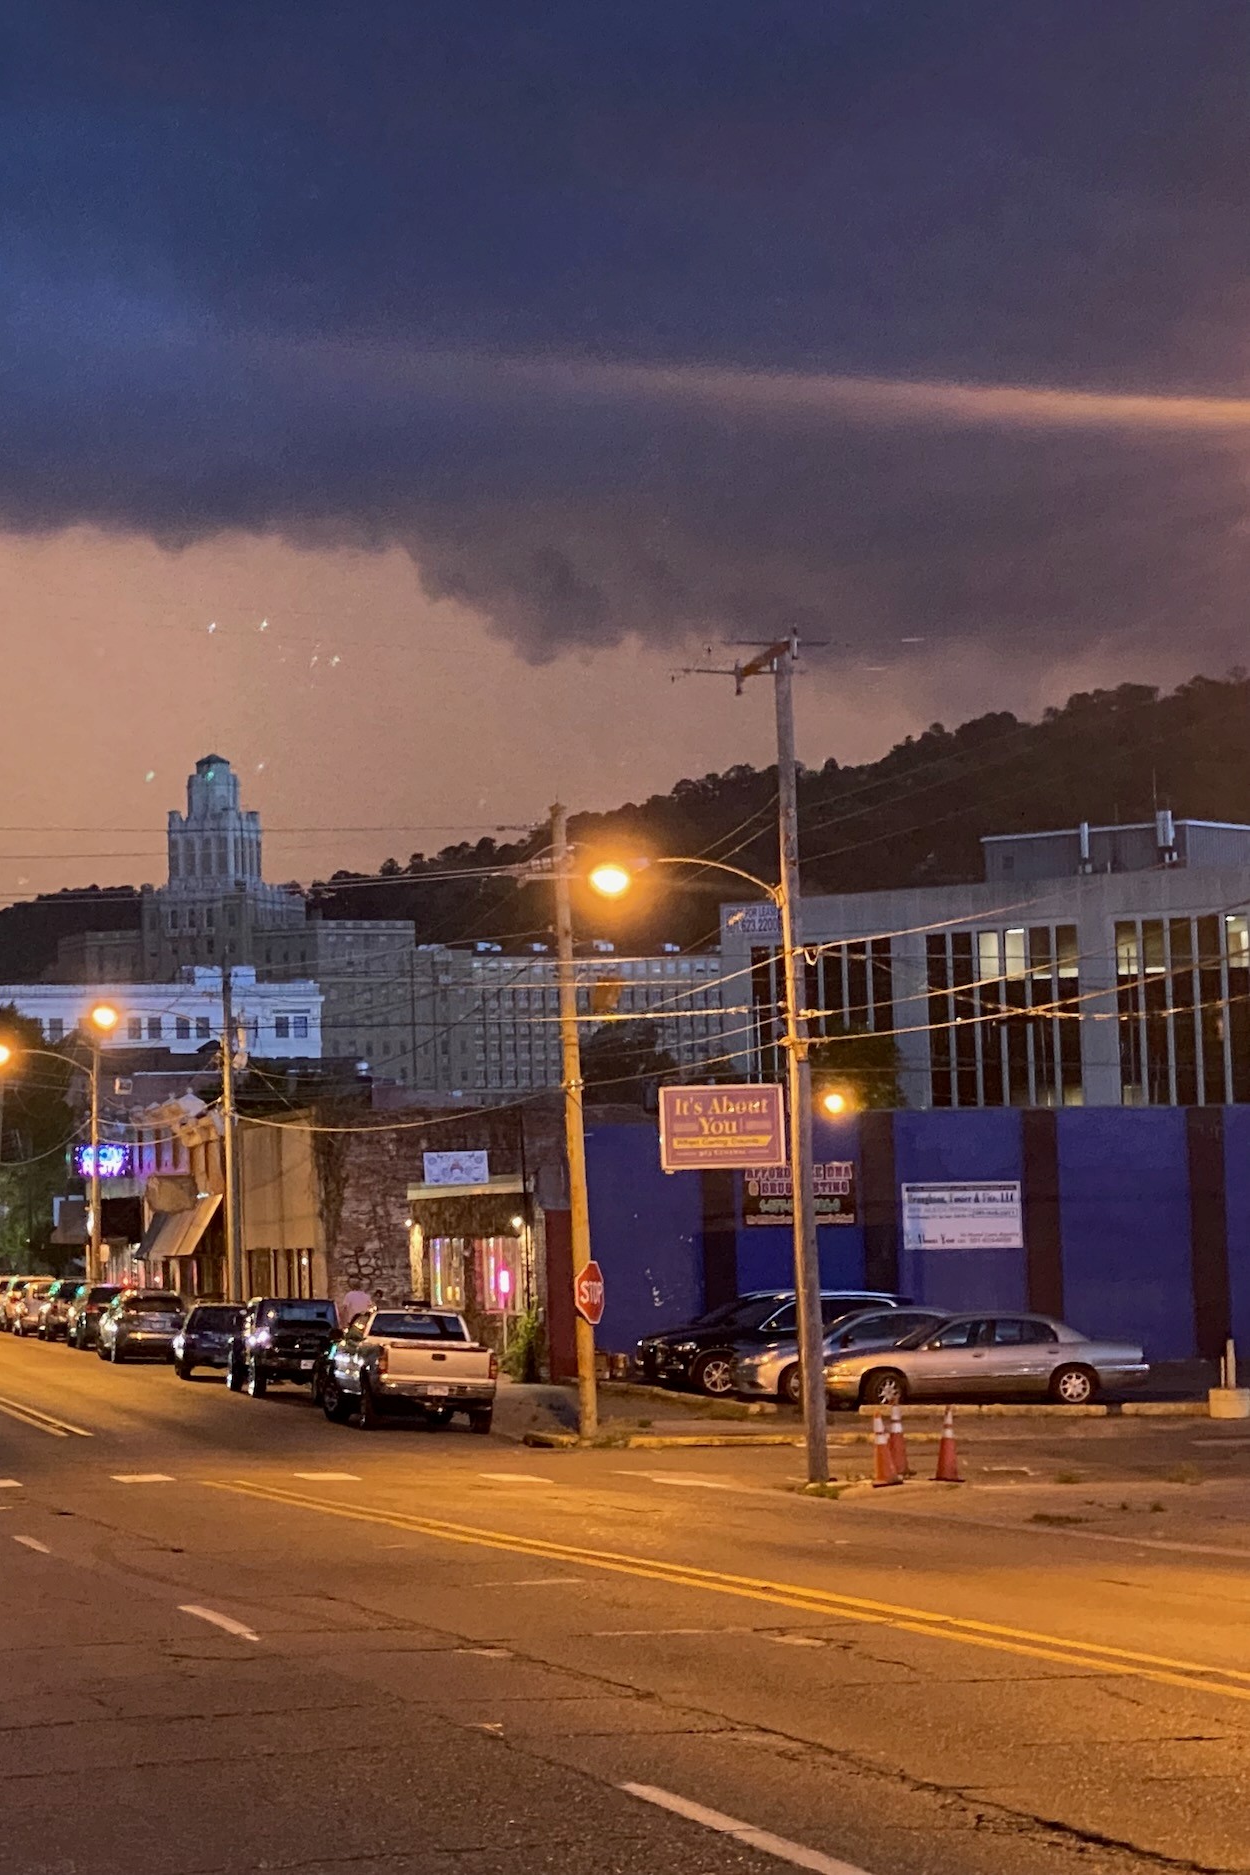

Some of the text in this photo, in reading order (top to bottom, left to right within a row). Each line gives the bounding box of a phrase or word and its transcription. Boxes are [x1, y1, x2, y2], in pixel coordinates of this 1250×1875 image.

[675, 1095, 768, 1116] It's About
[825, 1164, 853, 1179] DNA
[580, 1280, 603, 1304] STOP
